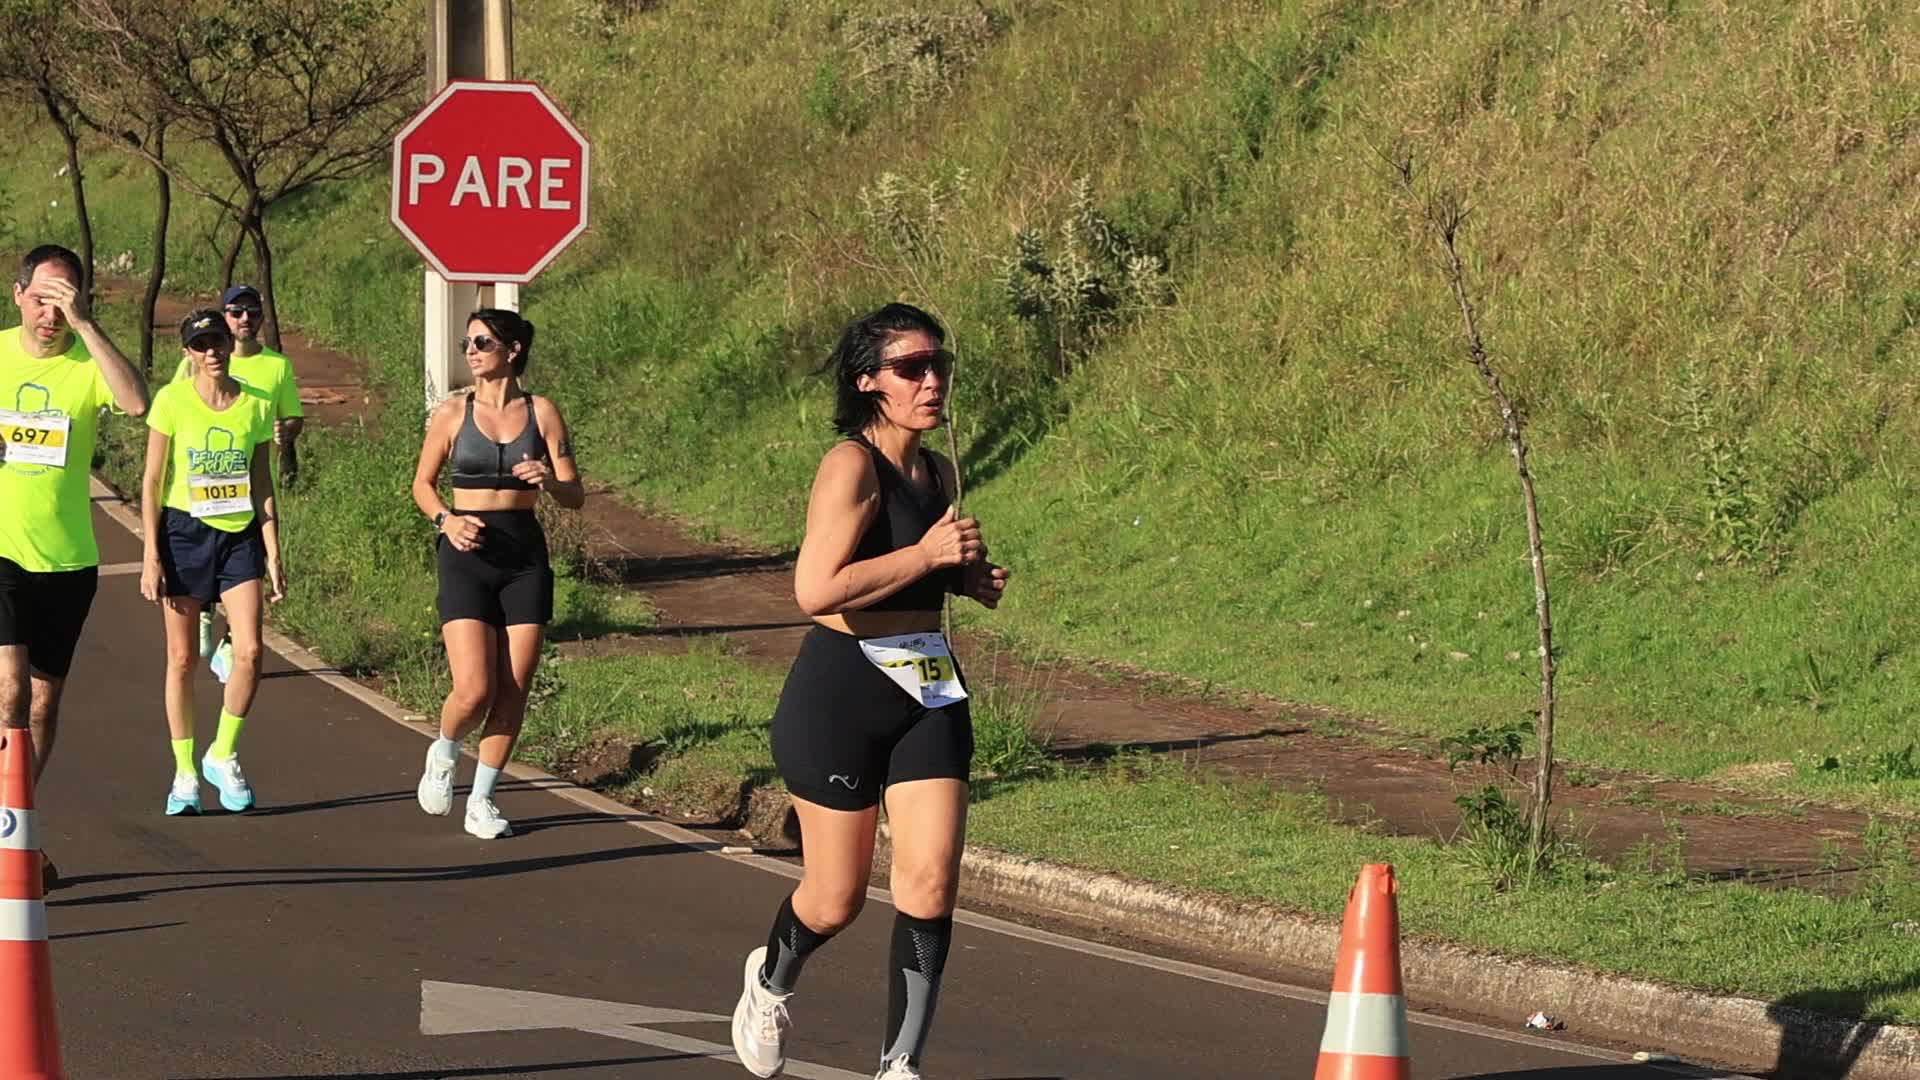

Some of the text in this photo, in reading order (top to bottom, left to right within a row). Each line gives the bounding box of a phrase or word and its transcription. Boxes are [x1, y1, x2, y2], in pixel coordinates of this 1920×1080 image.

[408, 153, 572, 210] PARE
[12, 427, 50, 445] 697
[203, 484, 238, 499] 1013
